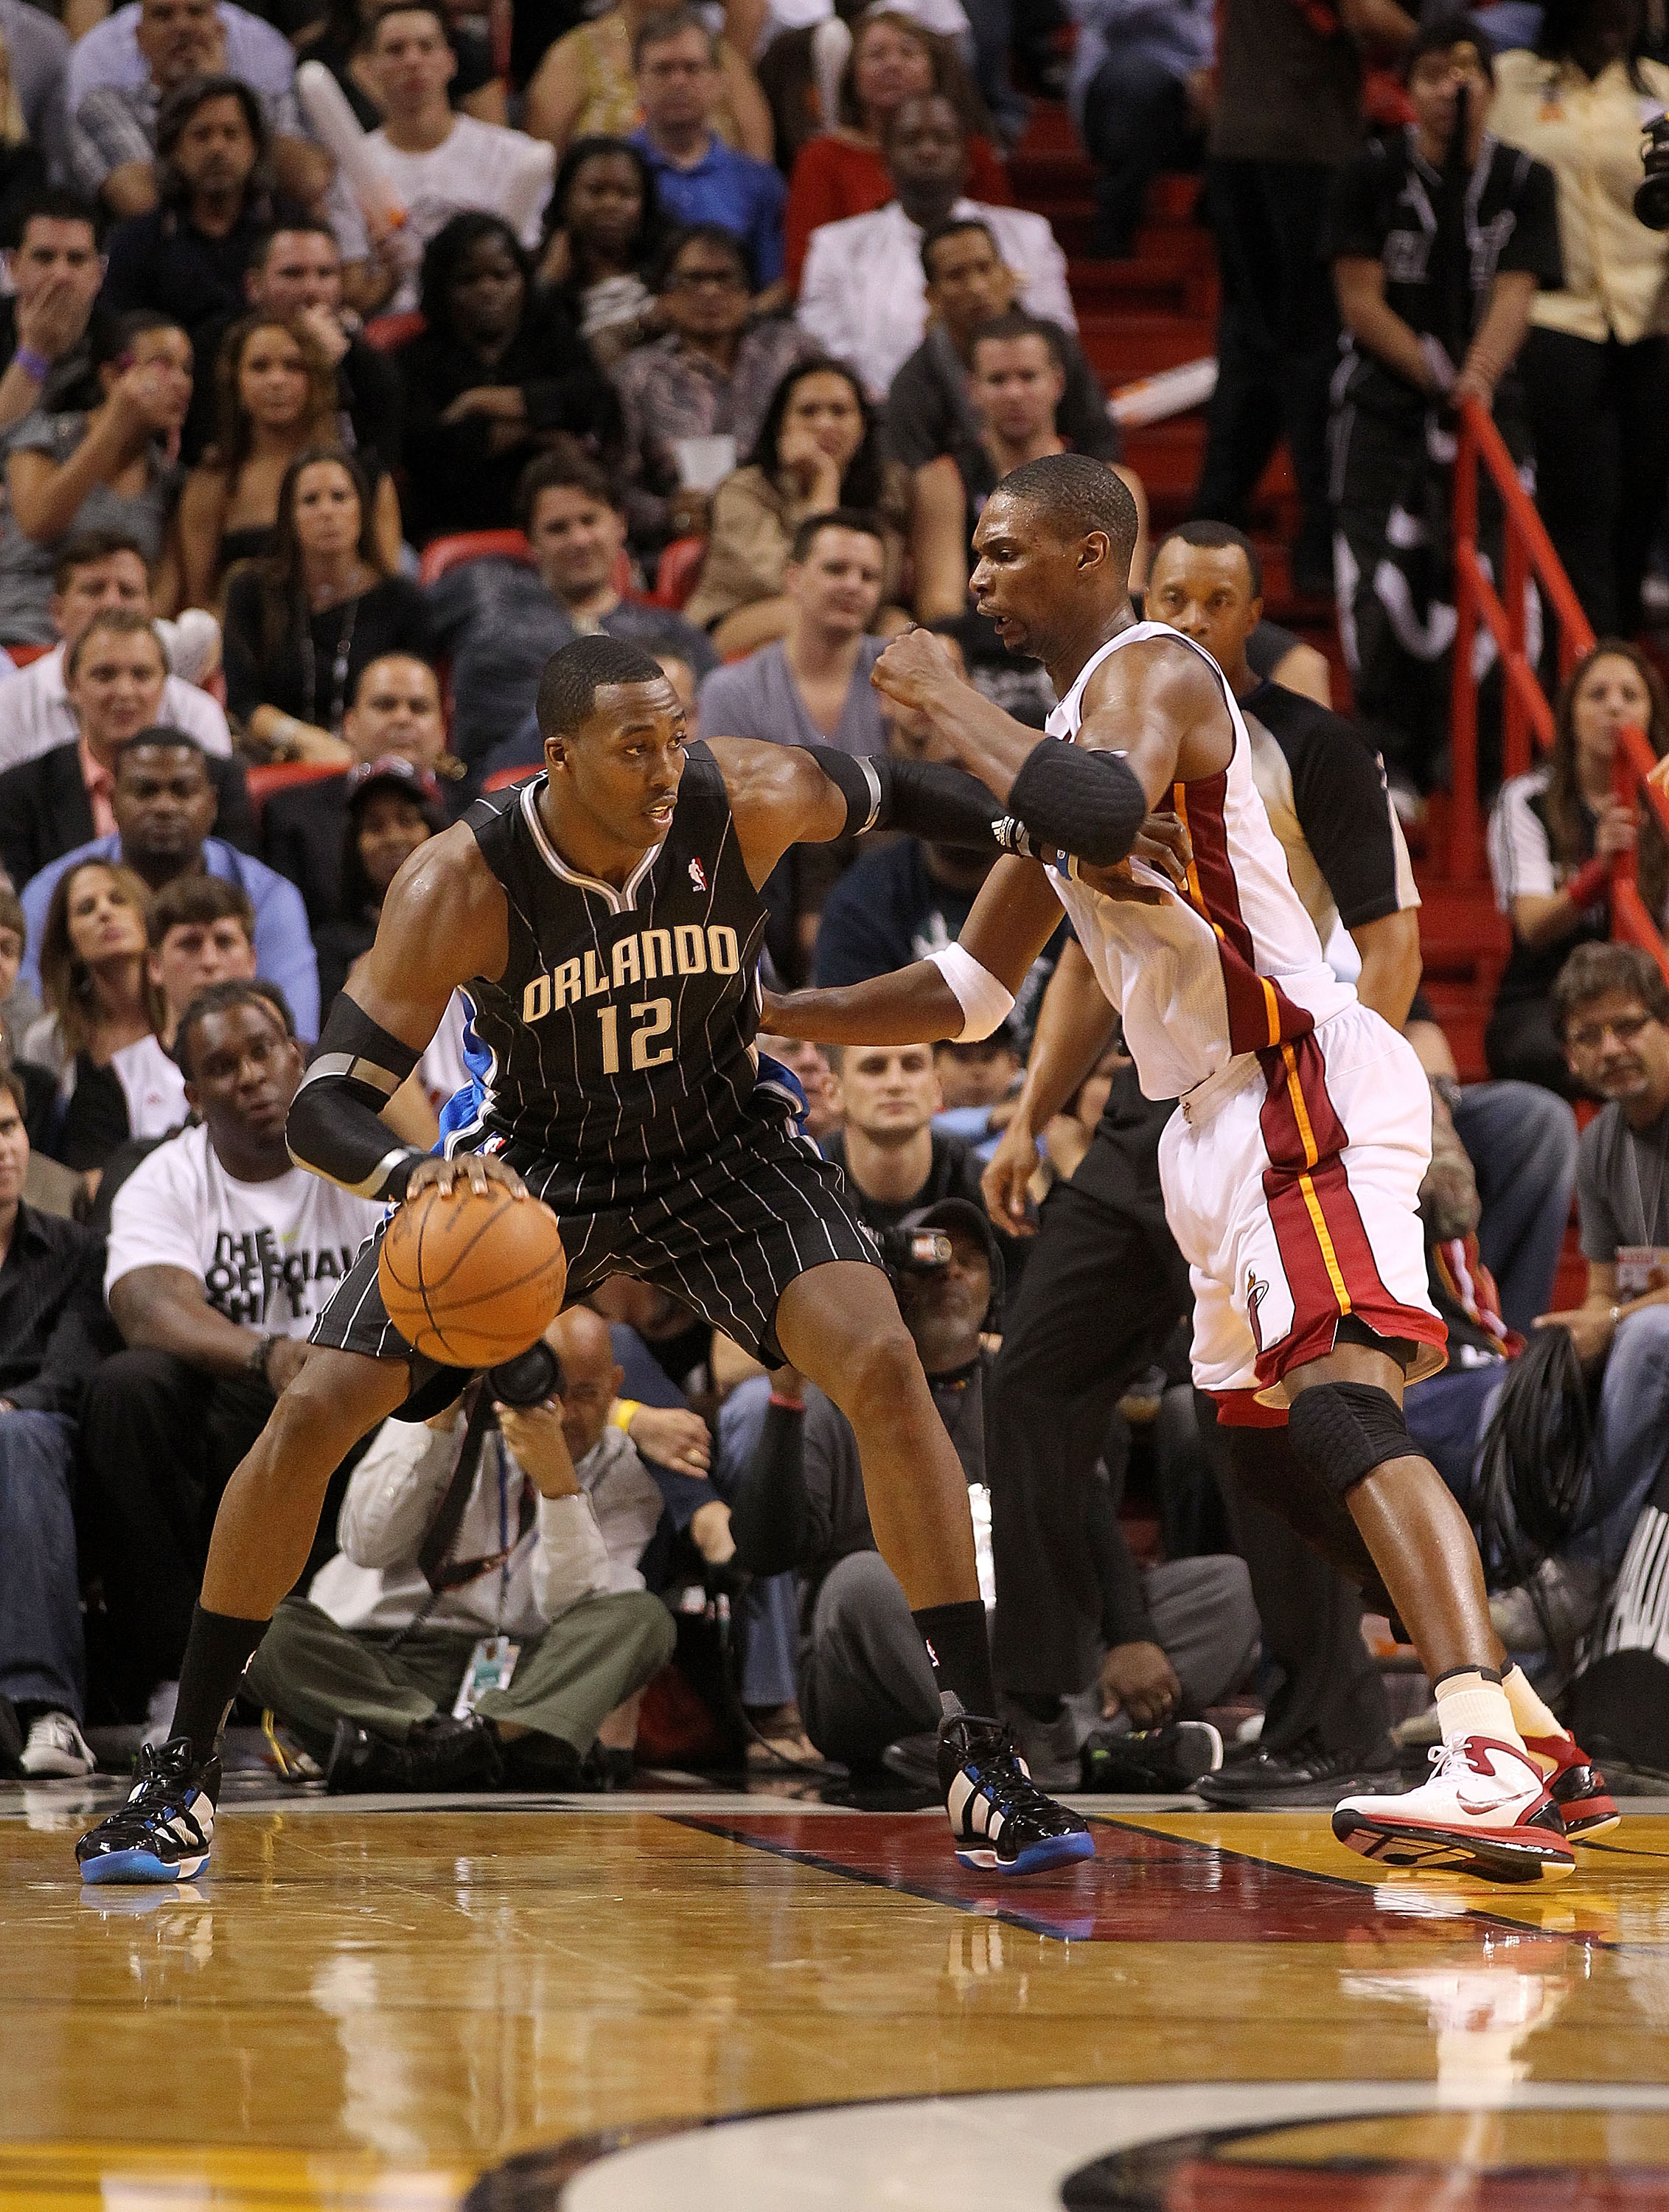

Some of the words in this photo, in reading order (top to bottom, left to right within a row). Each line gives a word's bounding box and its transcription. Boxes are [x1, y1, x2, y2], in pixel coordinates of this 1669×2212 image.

[523, 924, 739, 1023] ORLANDO
[597, 998, 674, 1074] 12
[206, 1246, 352, 1292] OFFCIAL
